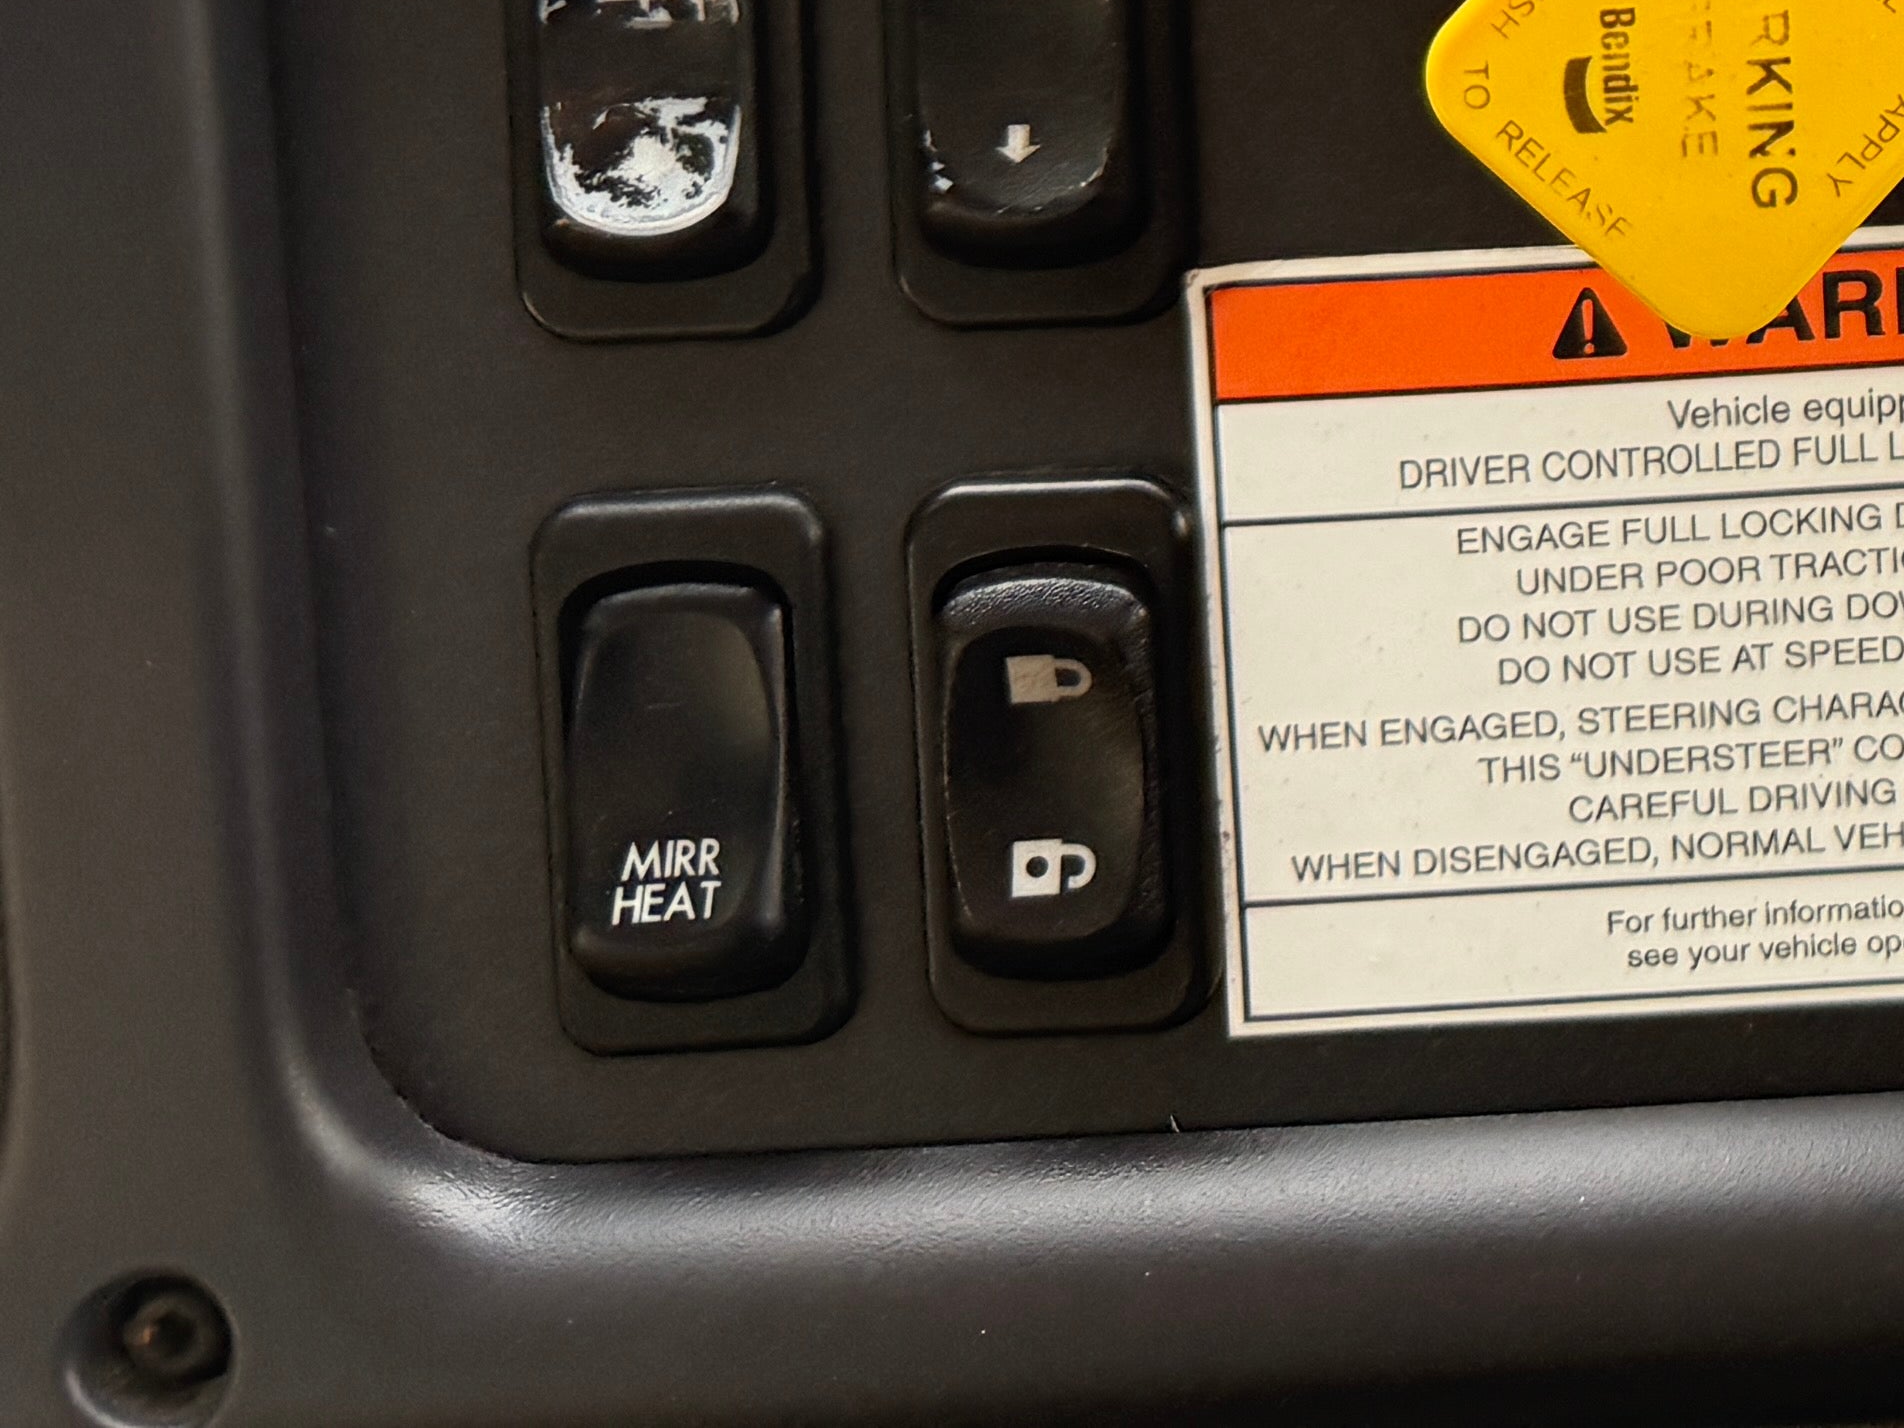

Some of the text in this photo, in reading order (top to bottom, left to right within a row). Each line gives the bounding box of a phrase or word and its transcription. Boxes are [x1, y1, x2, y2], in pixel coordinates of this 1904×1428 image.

[1462, 60, 1492, 111] TO
[1598, 6, 1640, 127] Bendix
[1667, 395, 1790, 429] Vehicle
[1400, 454, 1530, 490] DRIVER
[1542, 439, 1780, 482] CONTROLLED
[1794, 433, 1878, 466] FULL
[1458, 520, 1610, 555] ENGAGE
[1623, 515, 1710, 546] FULL
[1722, 504, 1881, 539] LOCKING
[1517, 563, 1643, 596] UNDER
[1656, 556, 1761, 588] POOR
[1458, 614, 1510, 643] DO
[1523, 609, 1596, 640] NOT
[1608, 604, 1681, 635] USE
[1694, 595, 1833, 629] DURING
[1499, 656, 1550, 685] DO
[1563, 651, 1636, 682] NOT
[1648, 646, 1721, 677] USE
[1732, 643, 1773, 673] AT
[1258, 720, 1366, 752] WHEN
[1380, 710, 1565, 746] ENGAGED,
[1578, 698, 1760, 735] STEERING
[1477, 754, 1561, 784] THIS
[1569, 788, 1738, 823] CAREFUL
[1749, 778, 1896, 813] DRIVING
[620, 838, 721, 882] MIRR
[1291, 850, 1400, 882] WHEN
[1414, 837, 1658, 875] DISENGAGED,
[1672, 827, 1825, 860] NORMAL
[611, 880, 722, 926] HEAT
[1607, 910, 1654, 935] For
[1662, 905, 1757, 932] further
[1628, 948, 1678, 968] see
[1688, 943, 1750, 971] your
[1759, 933, 1857, 961] vehicle
